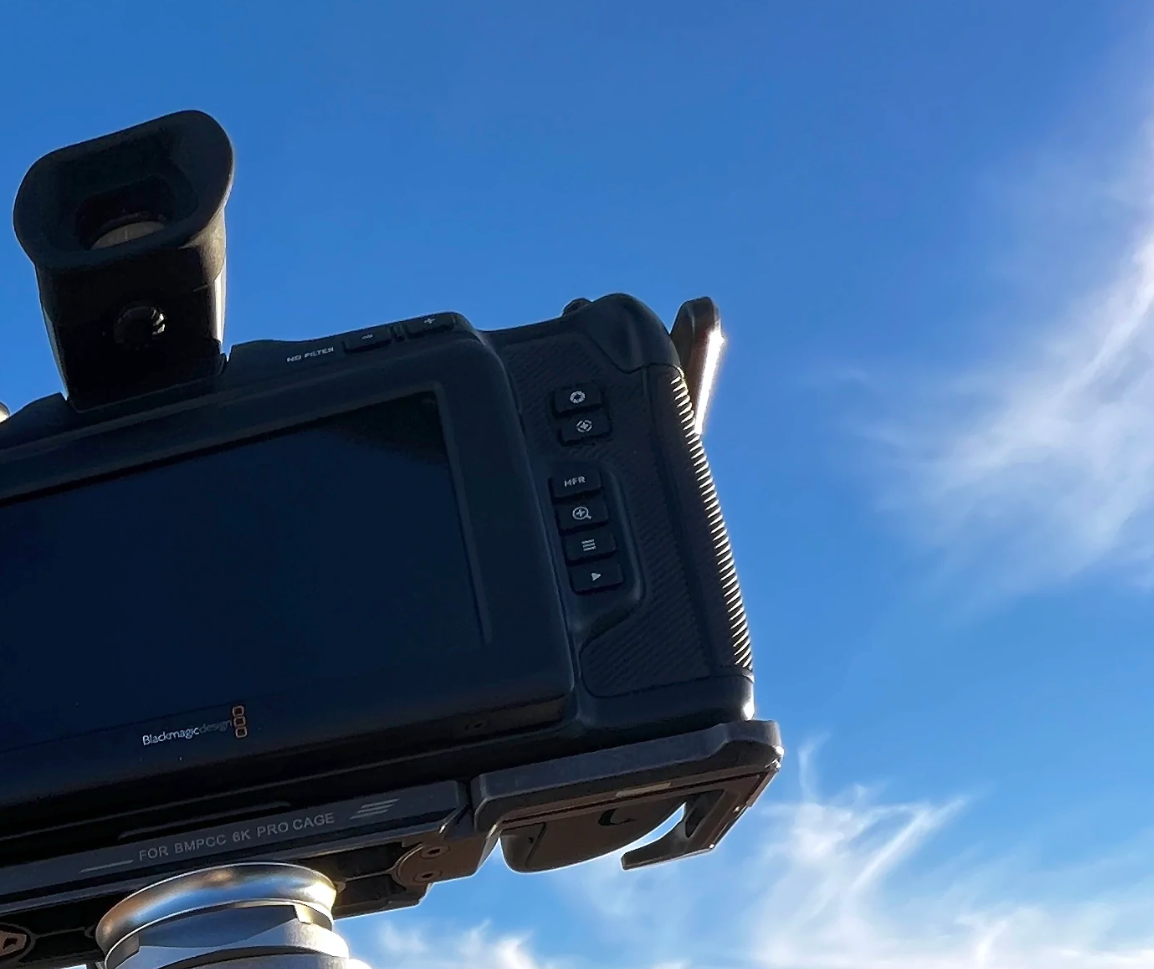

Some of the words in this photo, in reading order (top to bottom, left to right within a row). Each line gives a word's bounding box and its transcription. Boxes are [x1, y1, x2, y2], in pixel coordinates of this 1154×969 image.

[138, 845, 169, 861] FOR
[174, 834, 227, 855] BMPCC
[232, 829, 251, 843] 6K
[256, 821, 289, 838] PRO
[292, 812, 335, 830] CAGE
